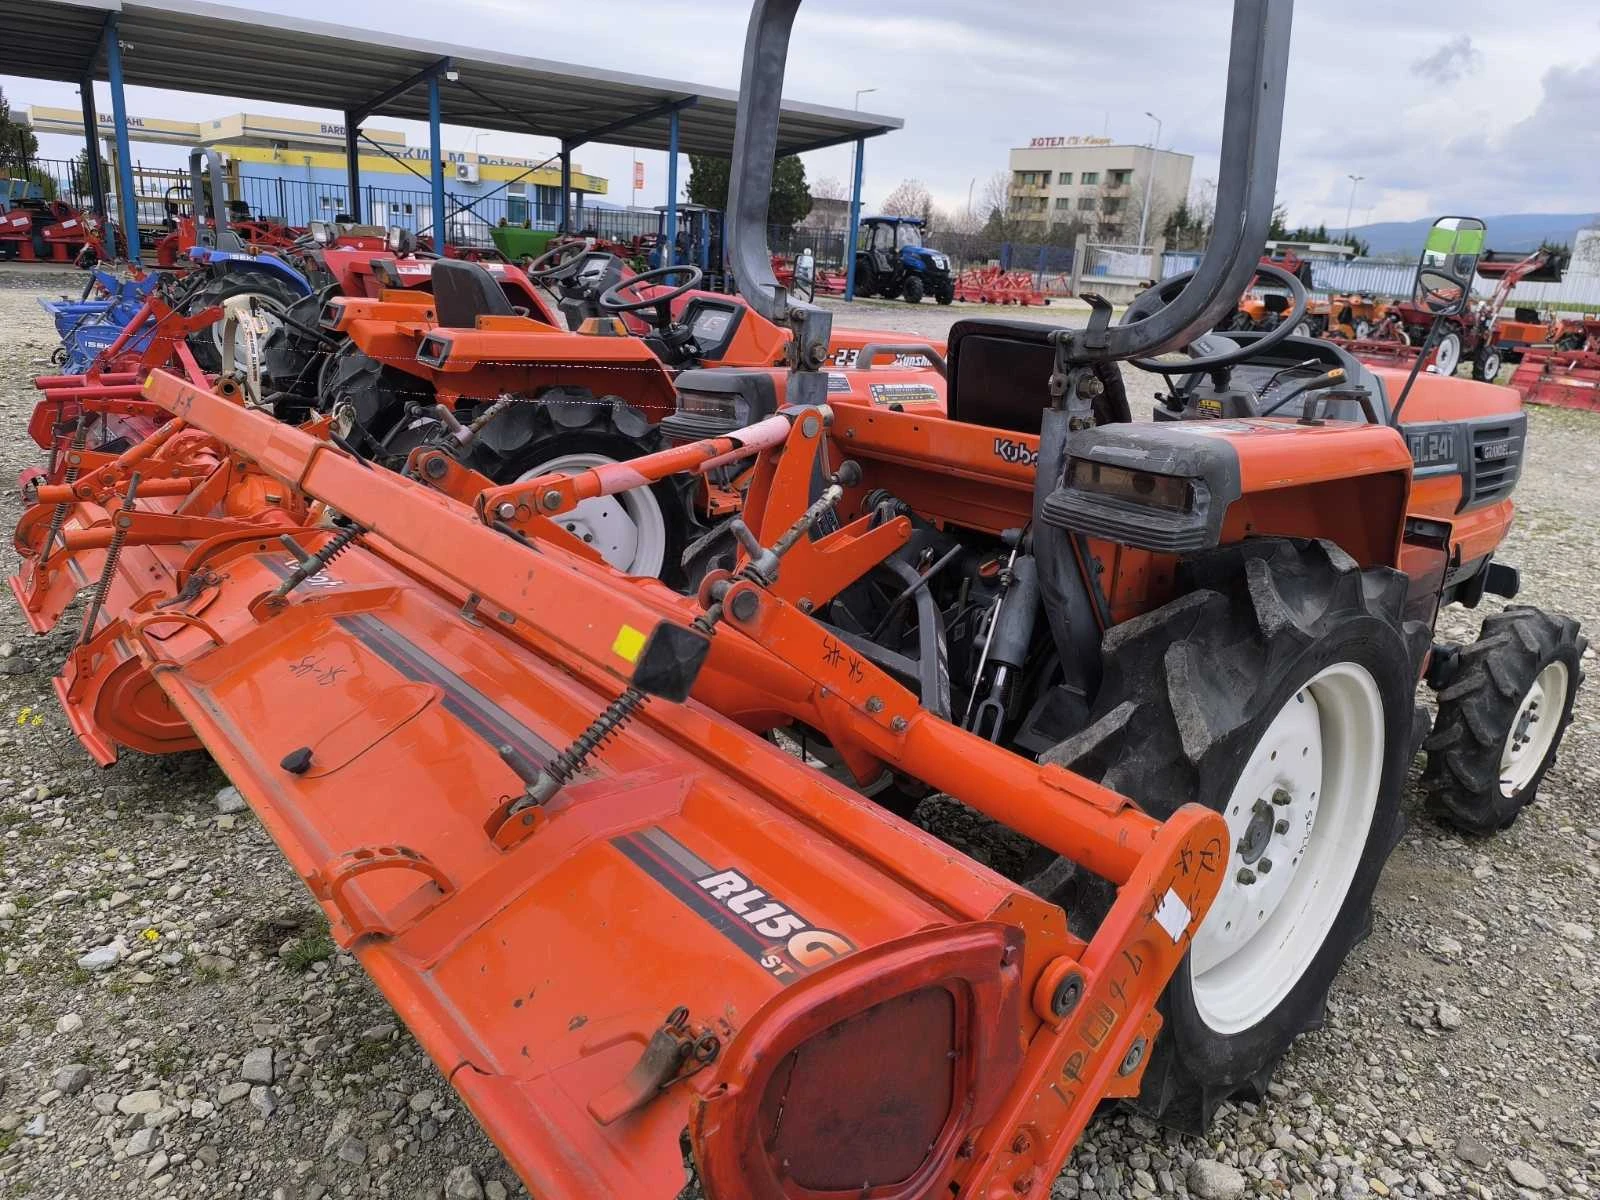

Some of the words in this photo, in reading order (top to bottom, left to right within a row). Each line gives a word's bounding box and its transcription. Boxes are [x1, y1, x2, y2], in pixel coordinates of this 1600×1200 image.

[99, 114, 145, 127] BAAHL
[320, 124, 347, 136] BARD
[1030, 136, 1065, 147] ХОТЕЛ
[229, 253, 257, 261] ISEKI
[84, 341, 113, 349] ISEK
[994, 438, 1040, 467] Kubo
[696, 868, 853, 968] RL15G
[760, 954, 795, 977] ST
